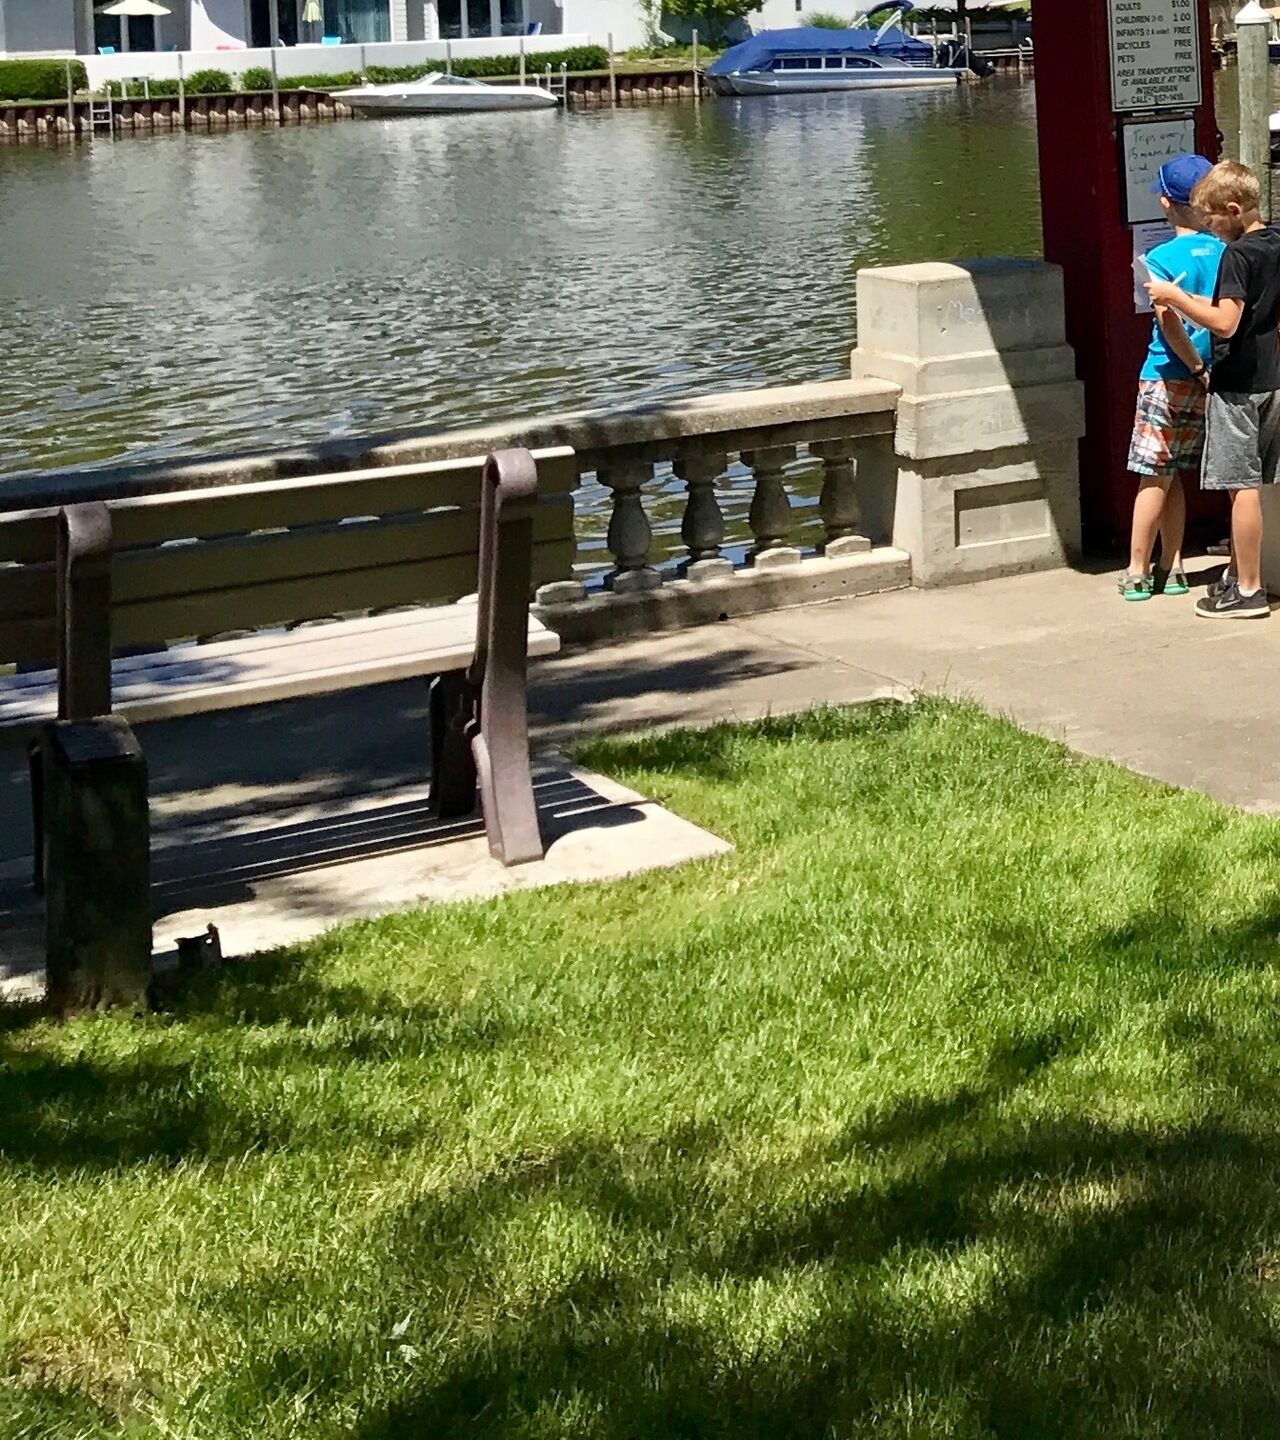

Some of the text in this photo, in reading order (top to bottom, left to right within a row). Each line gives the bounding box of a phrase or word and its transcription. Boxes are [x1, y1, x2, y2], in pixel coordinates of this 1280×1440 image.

[1116, 2, 1141, 11] ADULTS
[1116, 16, 1150, 24] CHILDREN
[1116, 28, 1144, 37] INFANTS
[1174, 26, 1191, 34] FREE
[1116, 39, 1192, 50] BICYCLES FREE
[1118, 55, 1136, 63] PETS
[1117, 66, 1195, 77] AREA TRANSPORTATION
[1131, 76, 1166, 85] AVAILABLE
